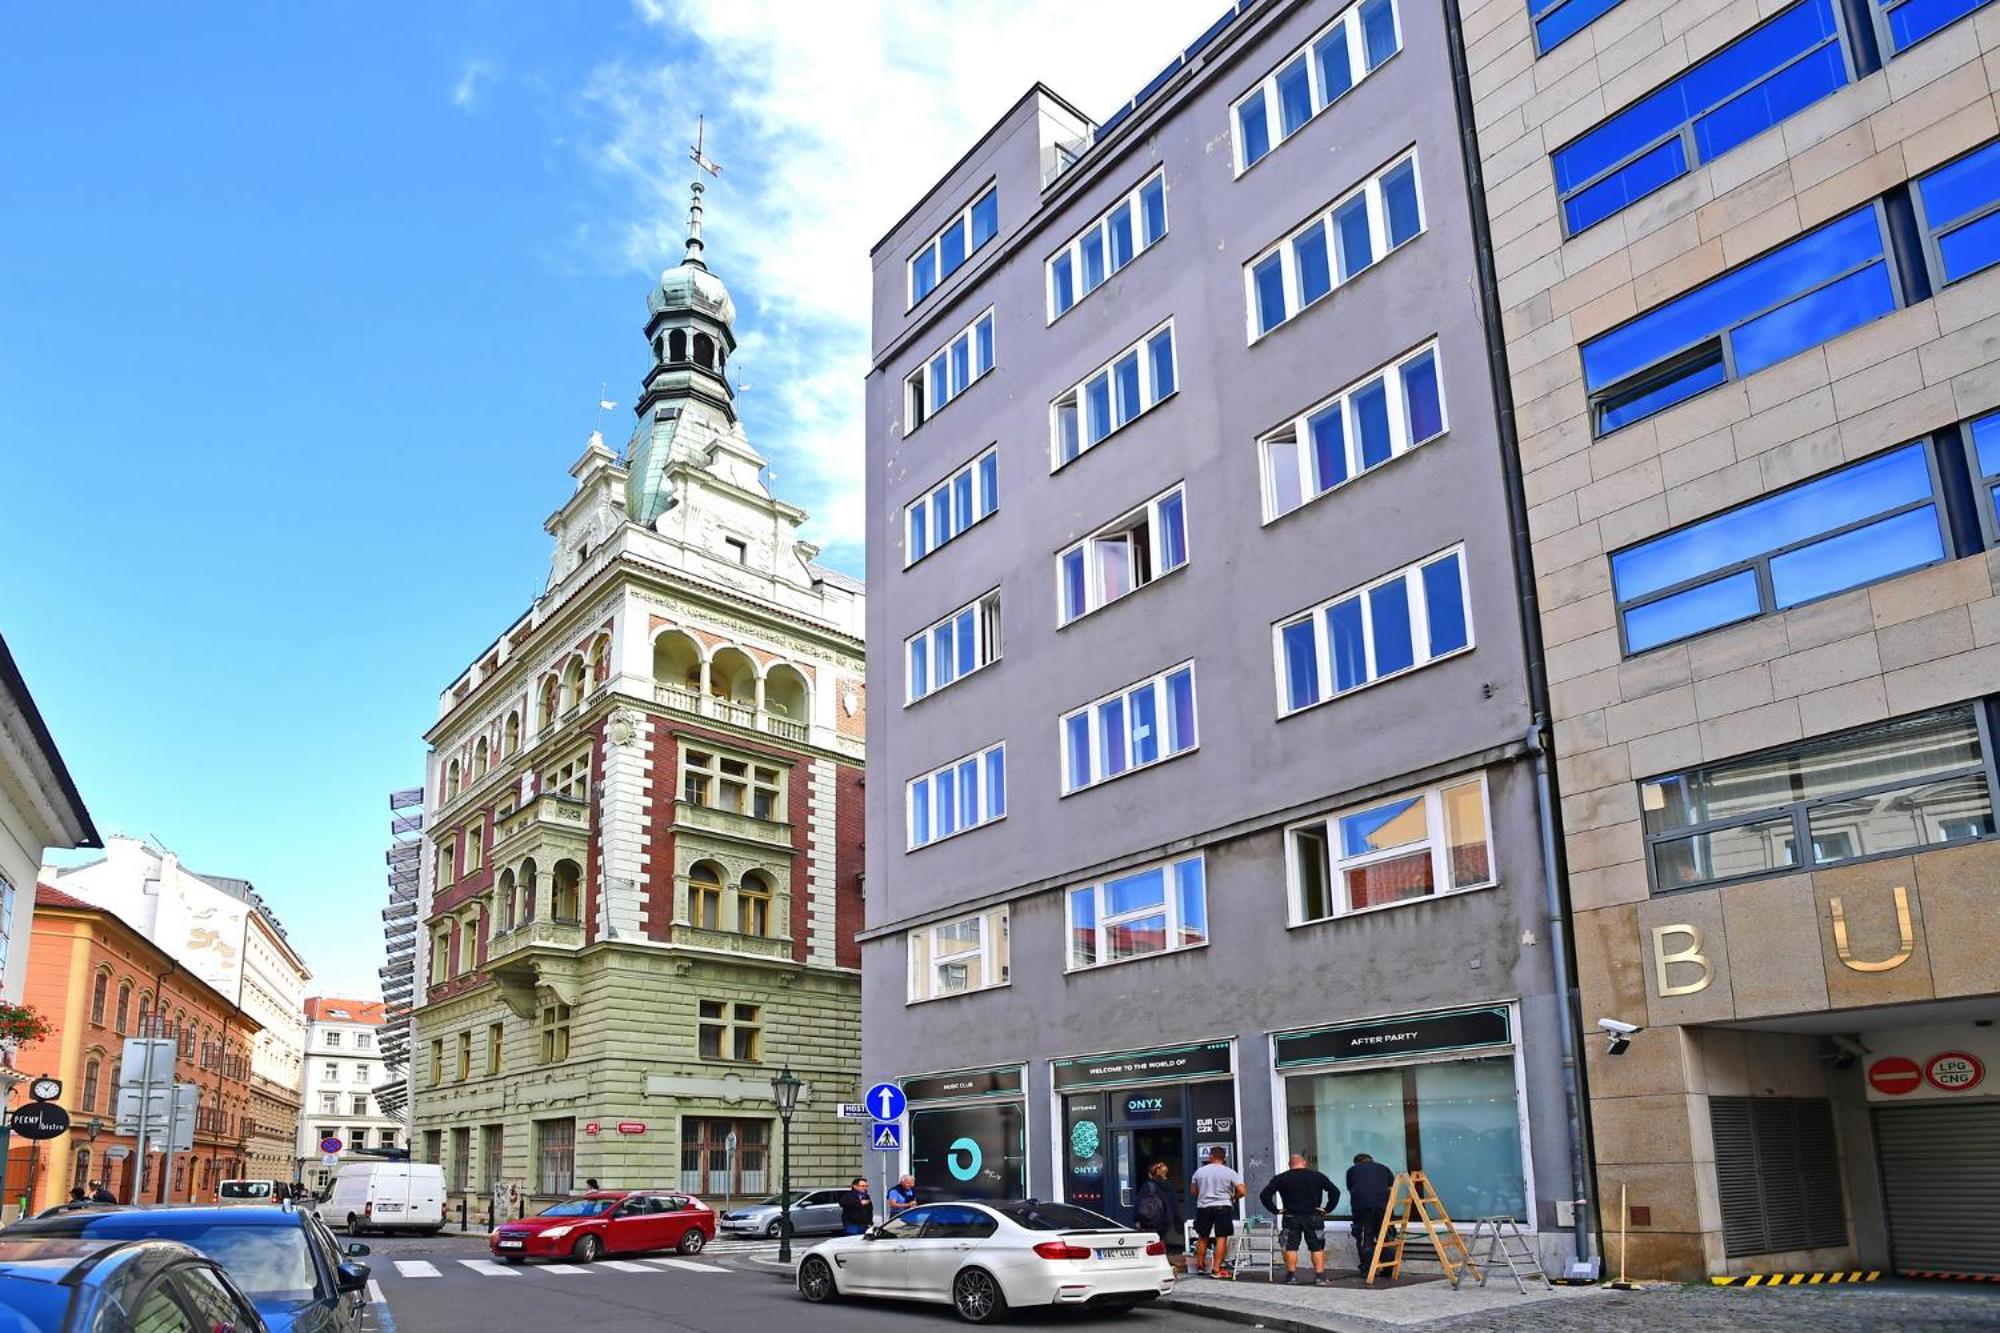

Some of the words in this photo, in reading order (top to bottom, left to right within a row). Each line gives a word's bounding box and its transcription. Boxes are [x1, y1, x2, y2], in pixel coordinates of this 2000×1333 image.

[1351, 1036, 1383, 1046] AFTER
[1384, 1032, 1418, 1042] PARTY
[1089, 1066, 1122, 1075] WELCOME
[1149, 1060, 1175, 1068] WORLD
[1939, 1062, 1966, 1071] LPG
[1940, 1074, 1969, 1083] CNG
[845, 1104, 866, 1113] HOST
[1128, 1098, 1163, 1110] ONYX
[41, 1122, 65, 1130] bistro
[1196, 1118, 1213, 1126] EUR
[1196, 1125, 1213, 1133] CZK
